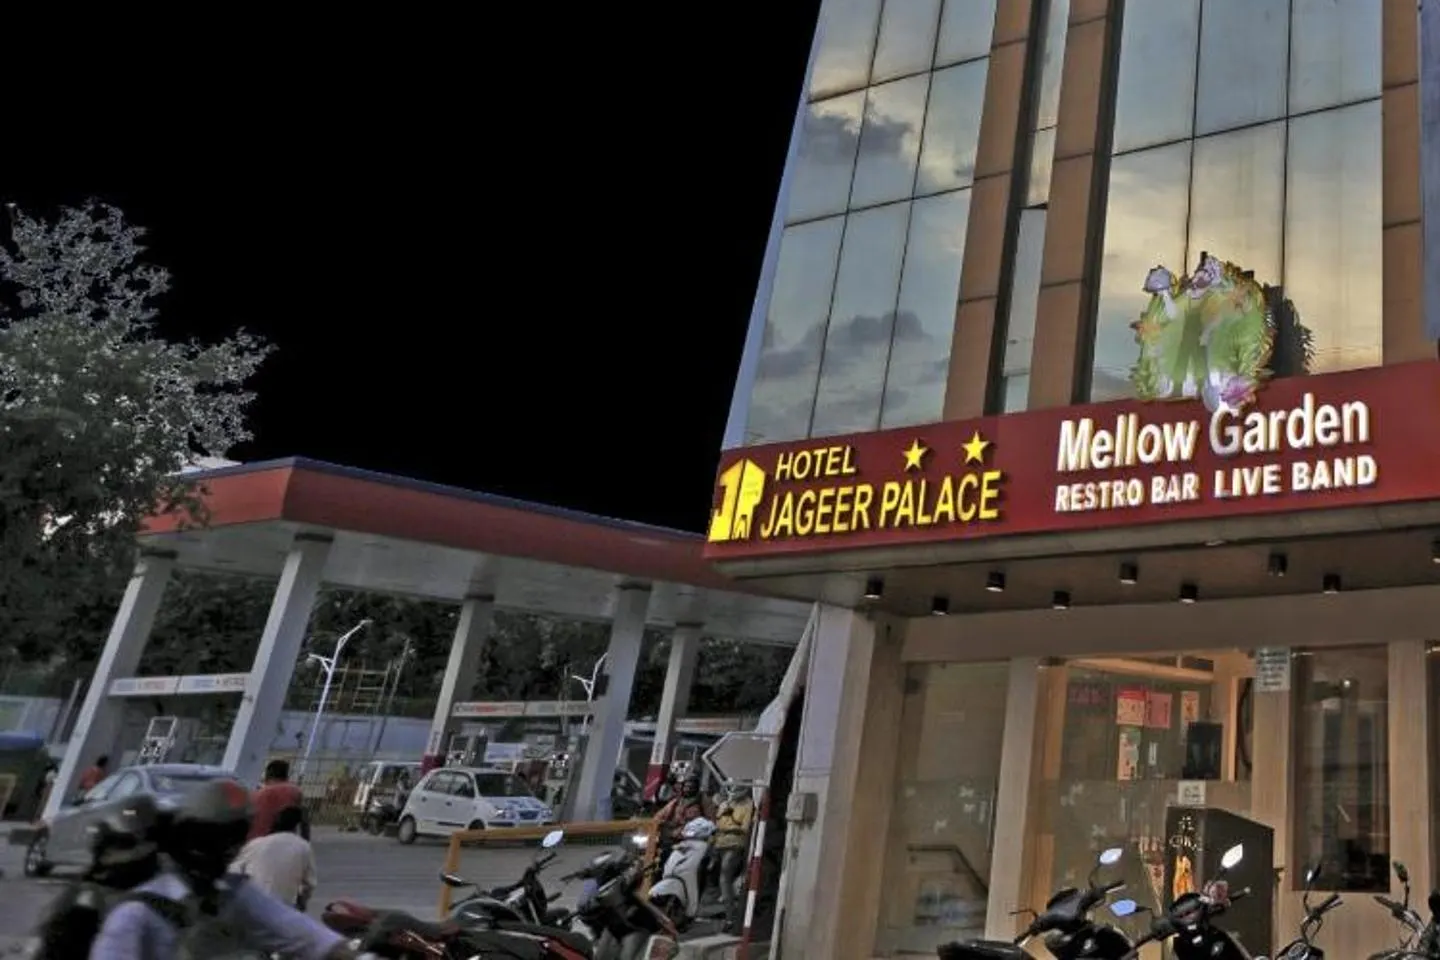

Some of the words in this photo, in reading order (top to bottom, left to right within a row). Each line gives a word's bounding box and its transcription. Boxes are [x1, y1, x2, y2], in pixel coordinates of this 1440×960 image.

[775, 445, 857, 481] HOTEL
[1056, 413, 1199, 471] Mellow
[1208, 392, 1370, 456] Garden
[760, 484, 873, 538] JAGEER
[878, 469, 1002, 528] PALACE
[1055, 478, 1143, 512] RESTRO
[1151, 472, 1199, 504] BAR
[1214, 463, 1282, 498] LIVE
[1291, 455, 1378, 490] BAND
